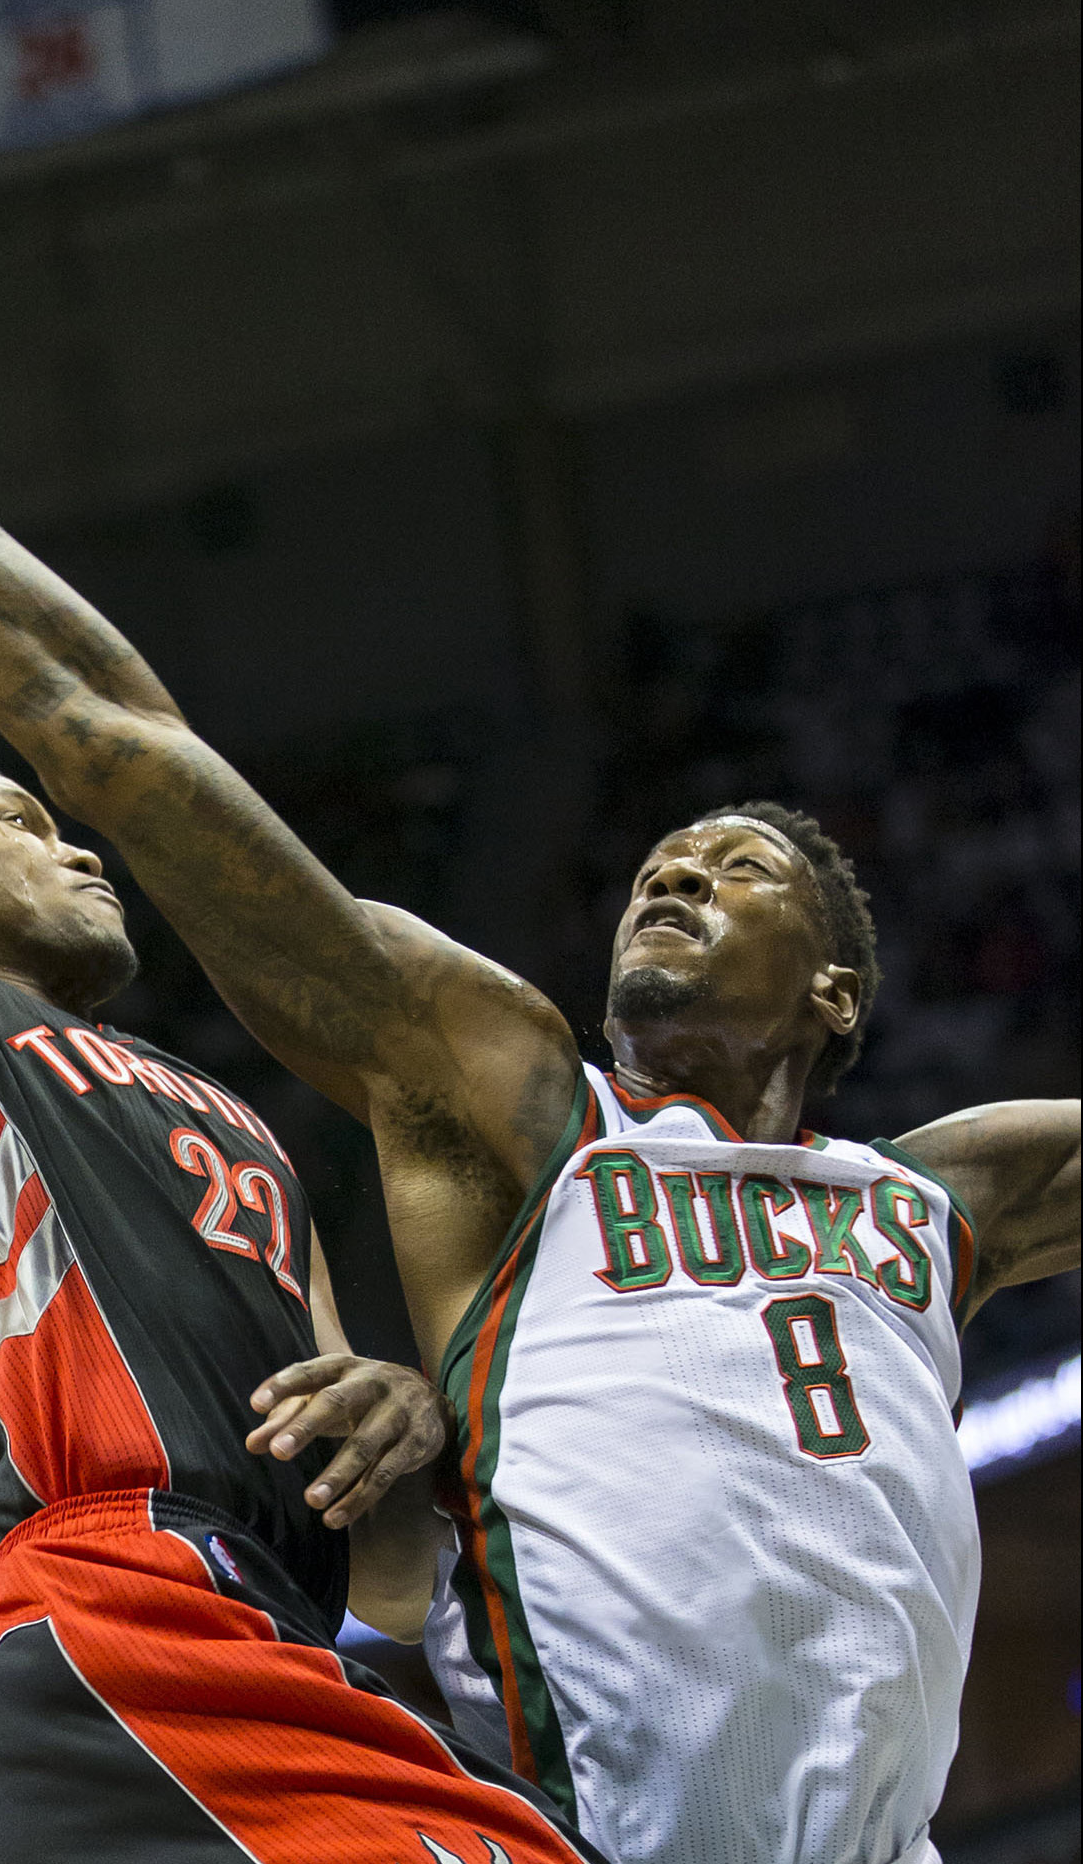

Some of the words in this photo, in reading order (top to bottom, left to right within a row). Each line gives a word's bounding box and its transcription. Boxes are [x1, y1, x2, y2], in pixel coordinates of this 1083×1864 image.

[6, 1025, 296, 1179] TORON
[169, 1127, 308, 1312] 22
[574, 1149, 932, 1313] BUCKS
[760, 1293, 872, 1461] 8
